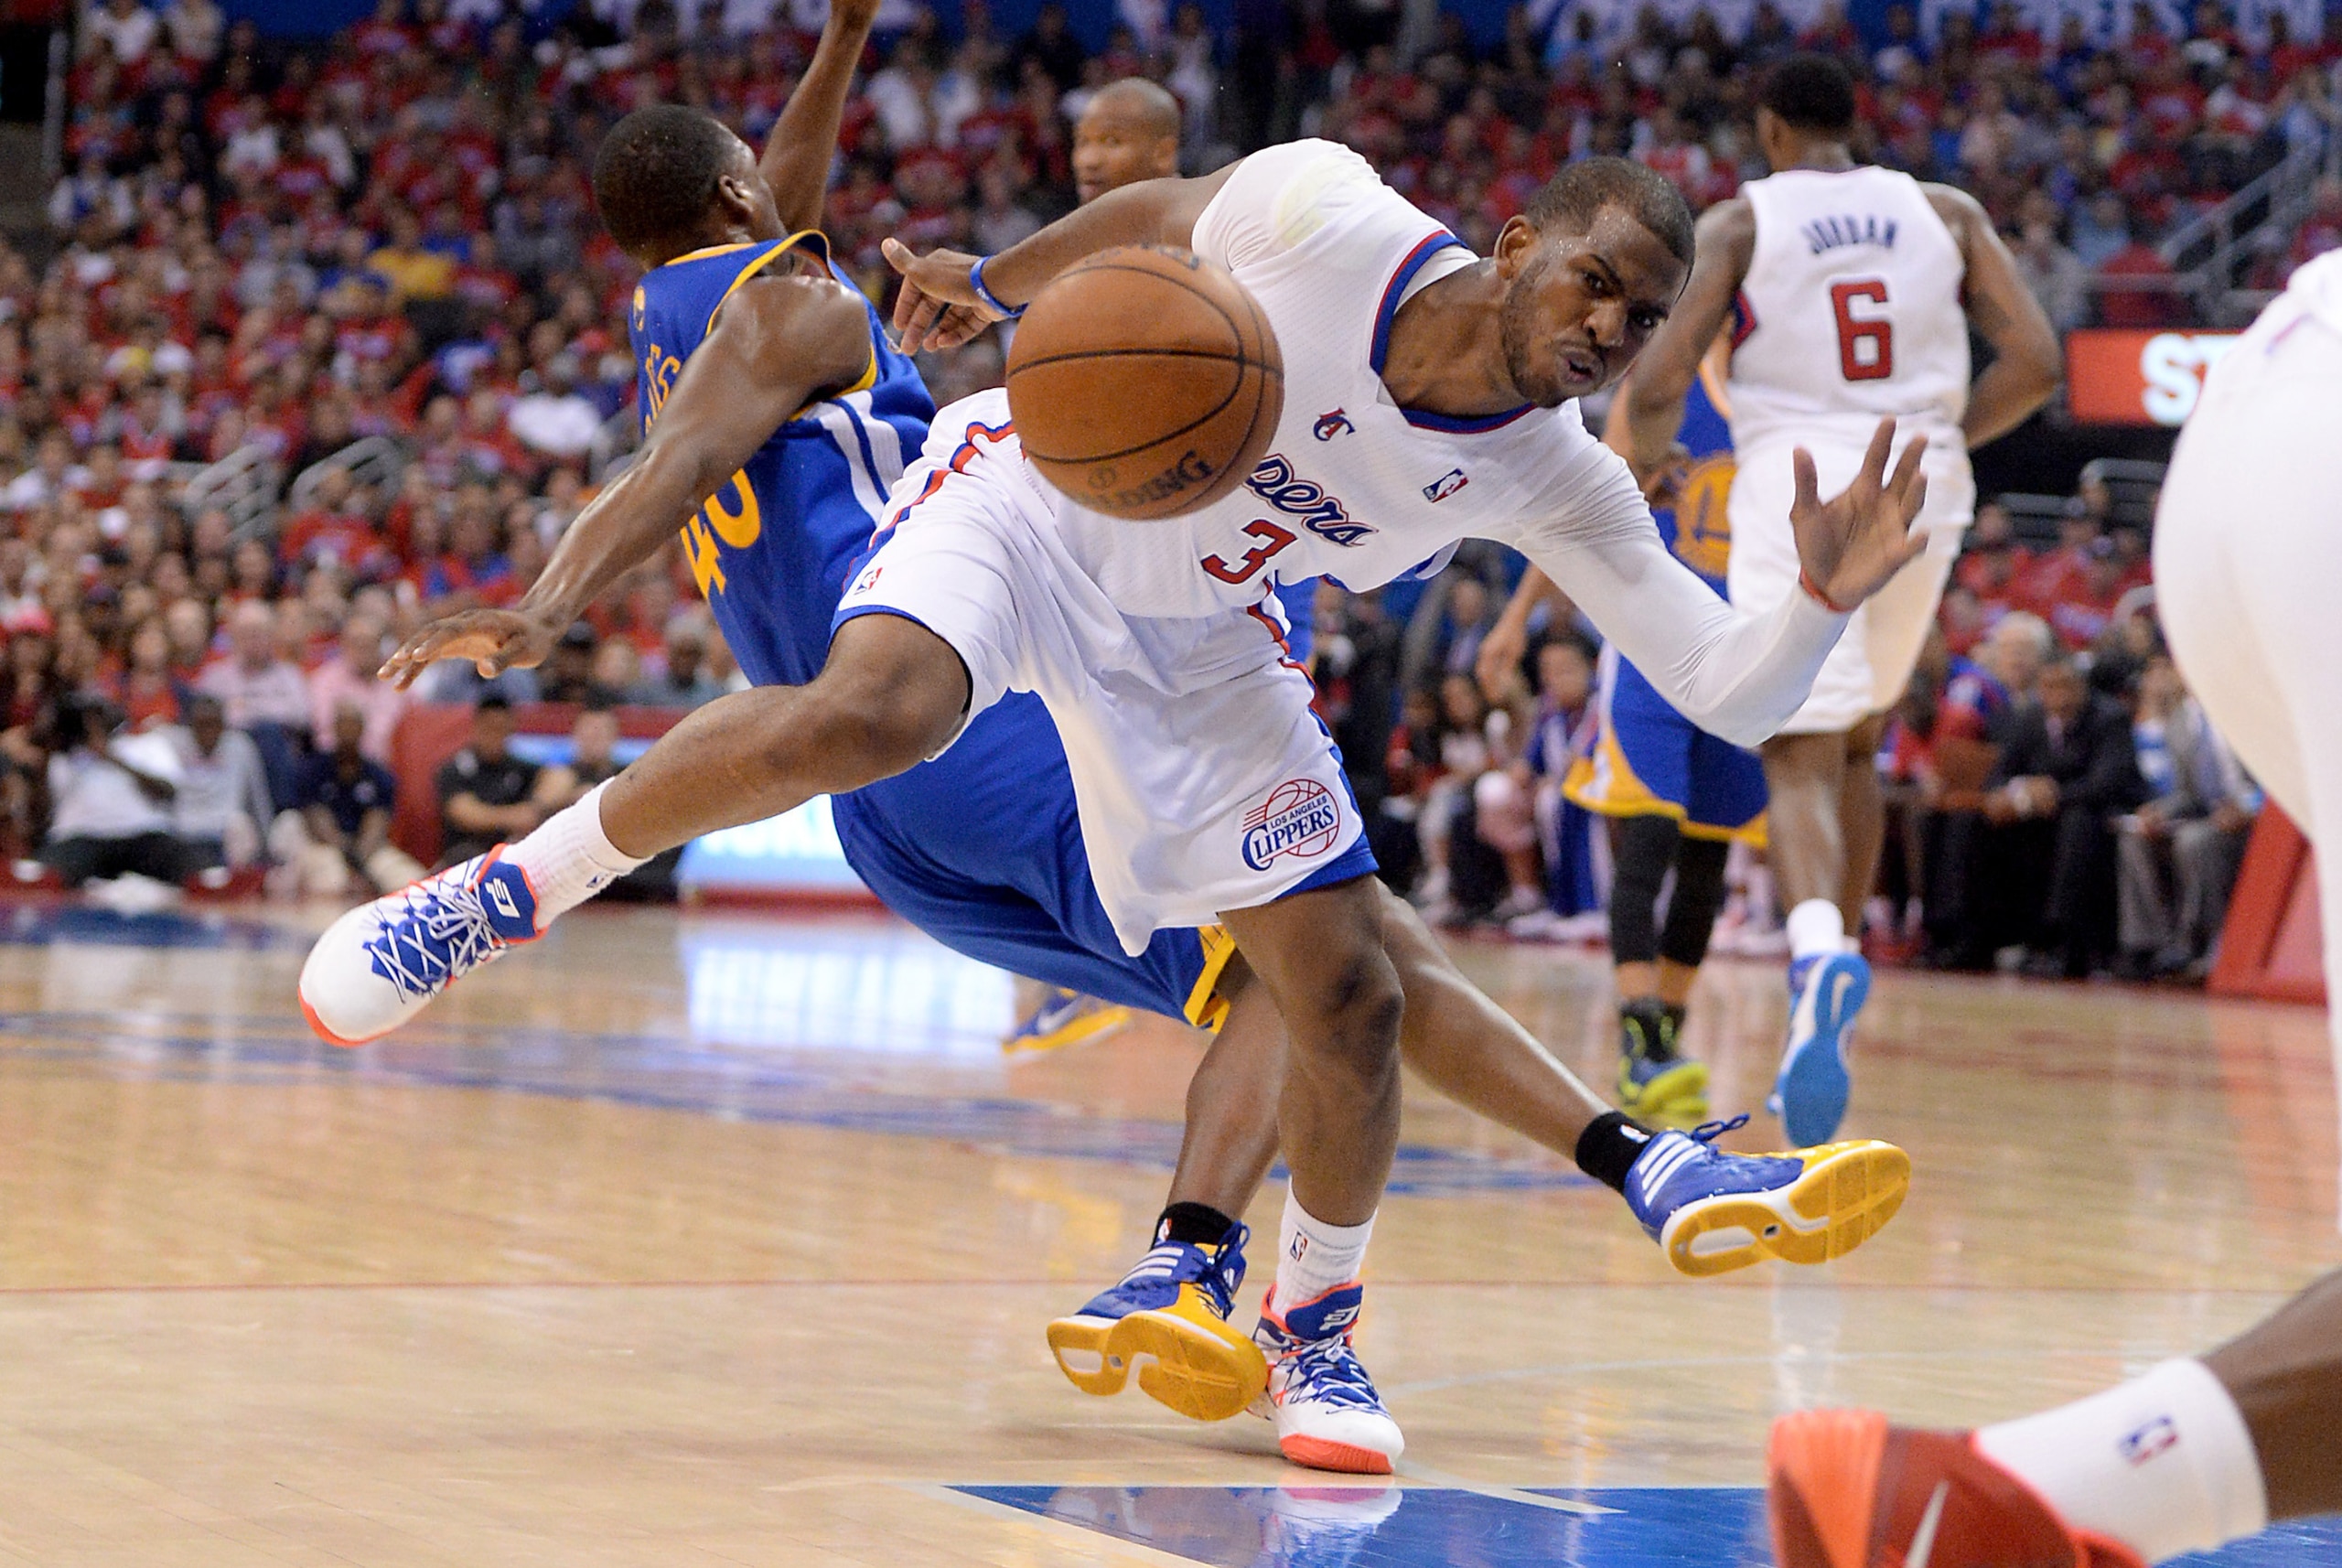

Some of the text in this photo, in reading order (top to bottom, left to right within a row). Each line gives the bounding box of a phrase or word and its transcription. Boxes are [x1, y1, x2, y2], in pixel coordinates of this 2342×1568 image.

[1831, 279, 1892, 381] 6
[680, 468, 761, 599] 40
[1199, 519, 1297, 585] 3
[1241, 805, 1334, 871] CLIPPERS
[1270, 795, 1327, 829] LOS ANGELES
